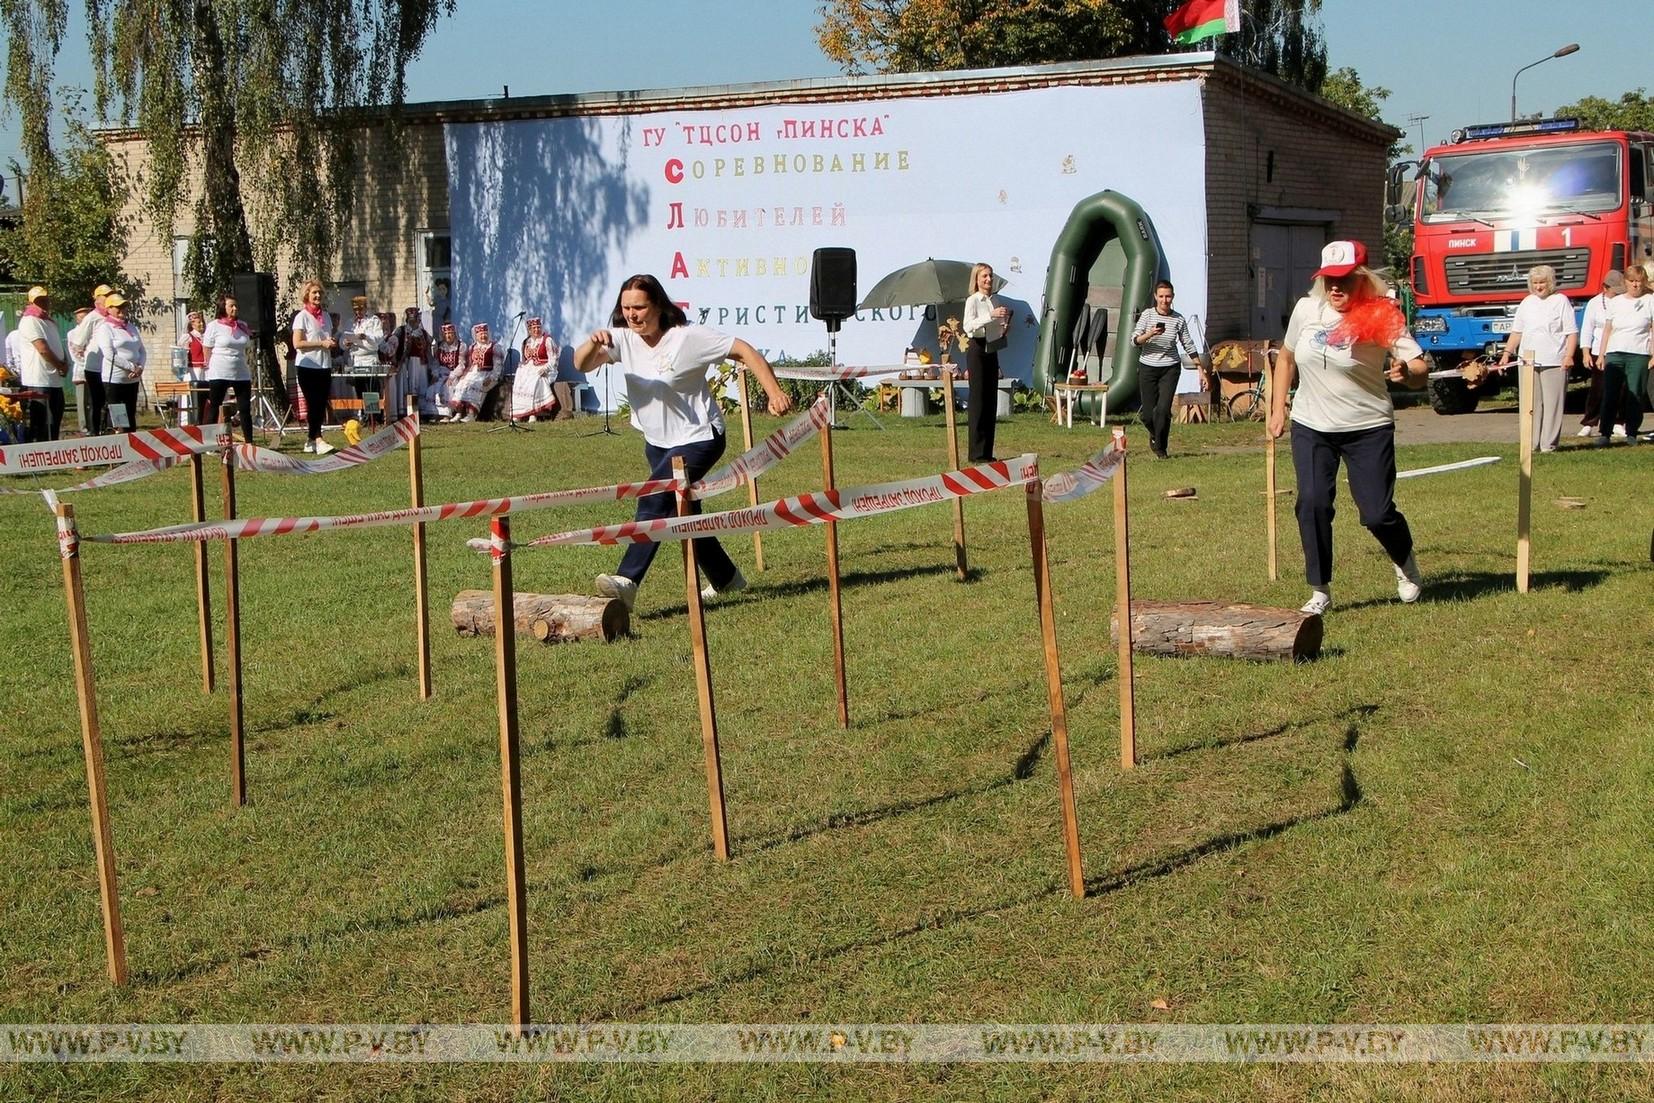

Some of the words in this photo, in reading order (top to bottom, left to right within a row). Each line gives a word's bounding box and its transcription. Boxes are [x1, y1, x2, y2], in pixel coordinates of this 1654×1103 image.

[643, 127, 666, 147] ГУ
[664, 151, 910, 184] СОРЕВНОВАНИЕ
[667, 202, 847, 230] ЛЮБИТЕЛЕЙ
[1448, 238, 1477, 249] ПИНСК
[1561, 227, 1572, 247] 1
[670, 251, 808, 279] АКТИВНО
[675, 301, 936, 325] УРИСТИСКОГО
[19, 448, 79, 469] ЗАПРЕЩЕН!
[80, 444, 123, 463] ПРОХОД
[903, 486, 942, 505] ПРОХОД
[728, 510, 768, 529] ПРОХОД
